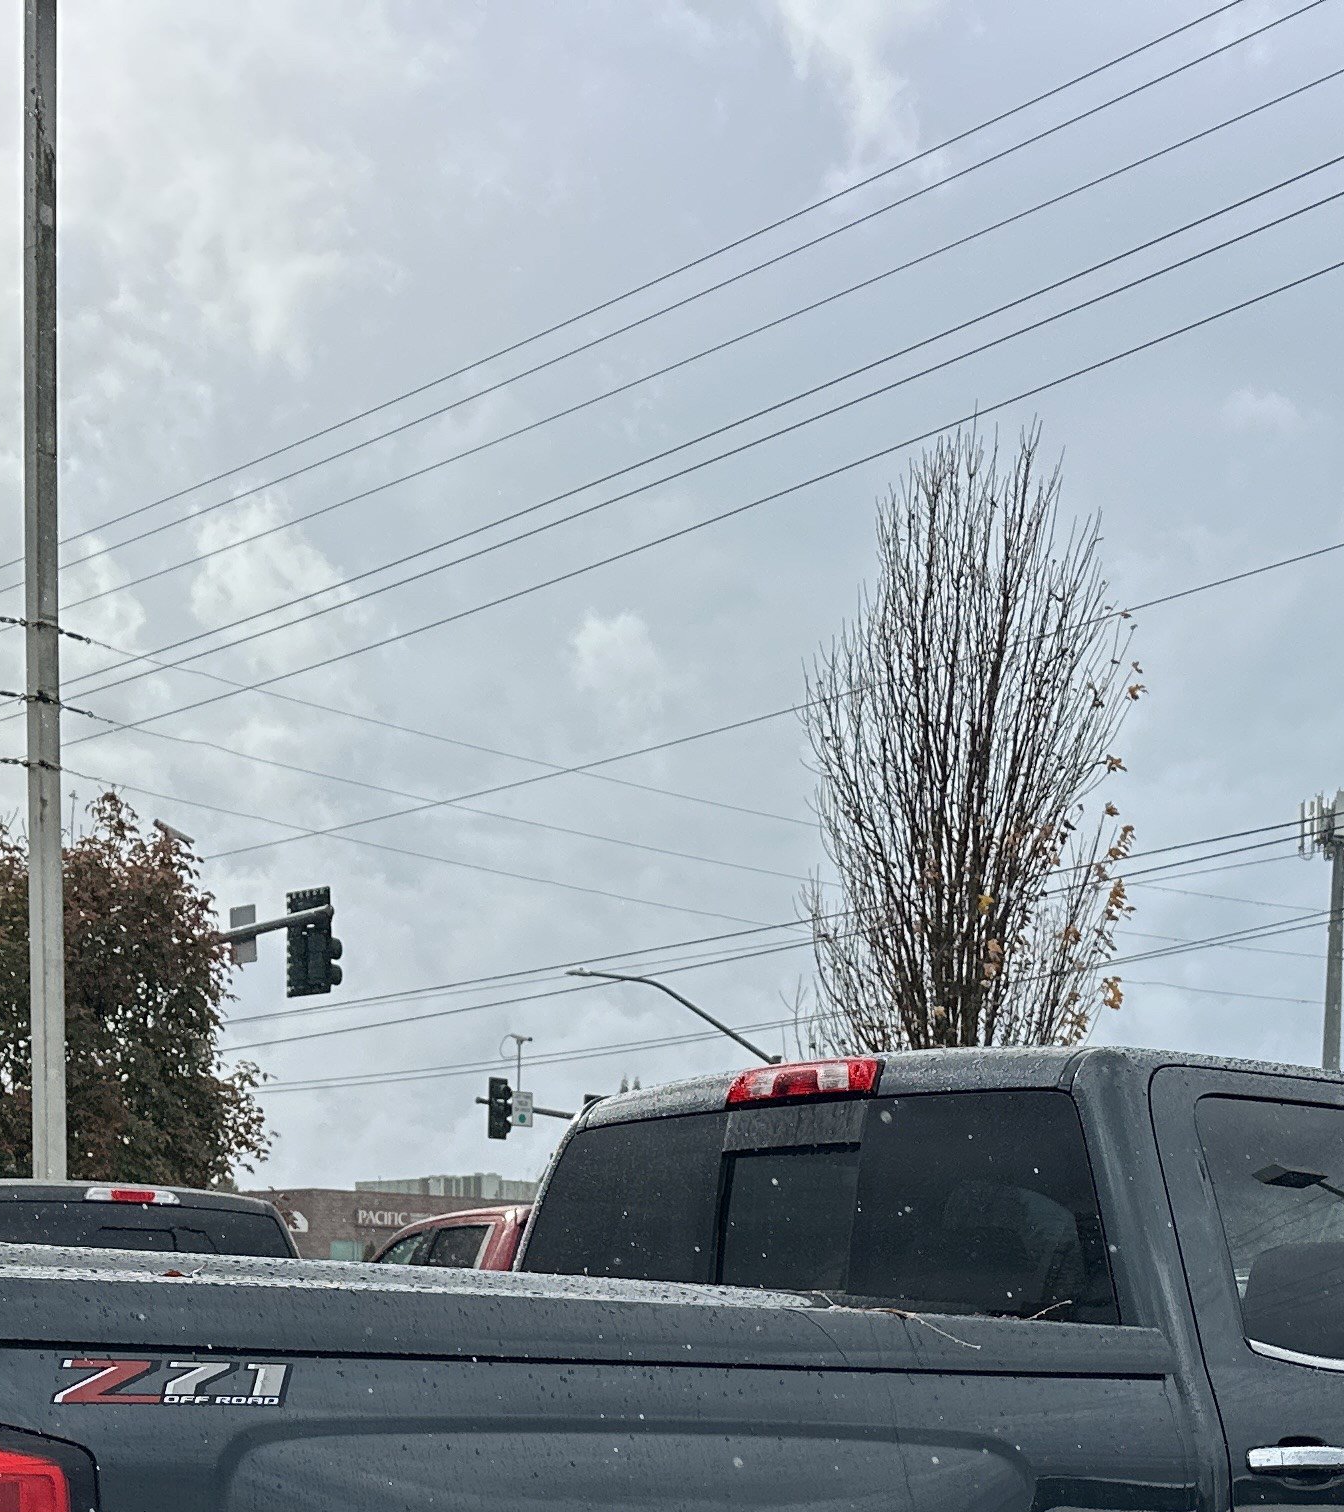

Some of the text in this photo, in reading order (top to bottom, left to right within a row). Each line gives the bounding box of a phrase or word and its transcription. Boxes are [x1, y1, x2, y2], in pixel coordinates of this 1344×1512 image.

[358, 1209, 408, 1226] PACIFIC
[50, 1357, 294, 1405] Z71
[163, 1395, 280, 1406] OFF ROAD
